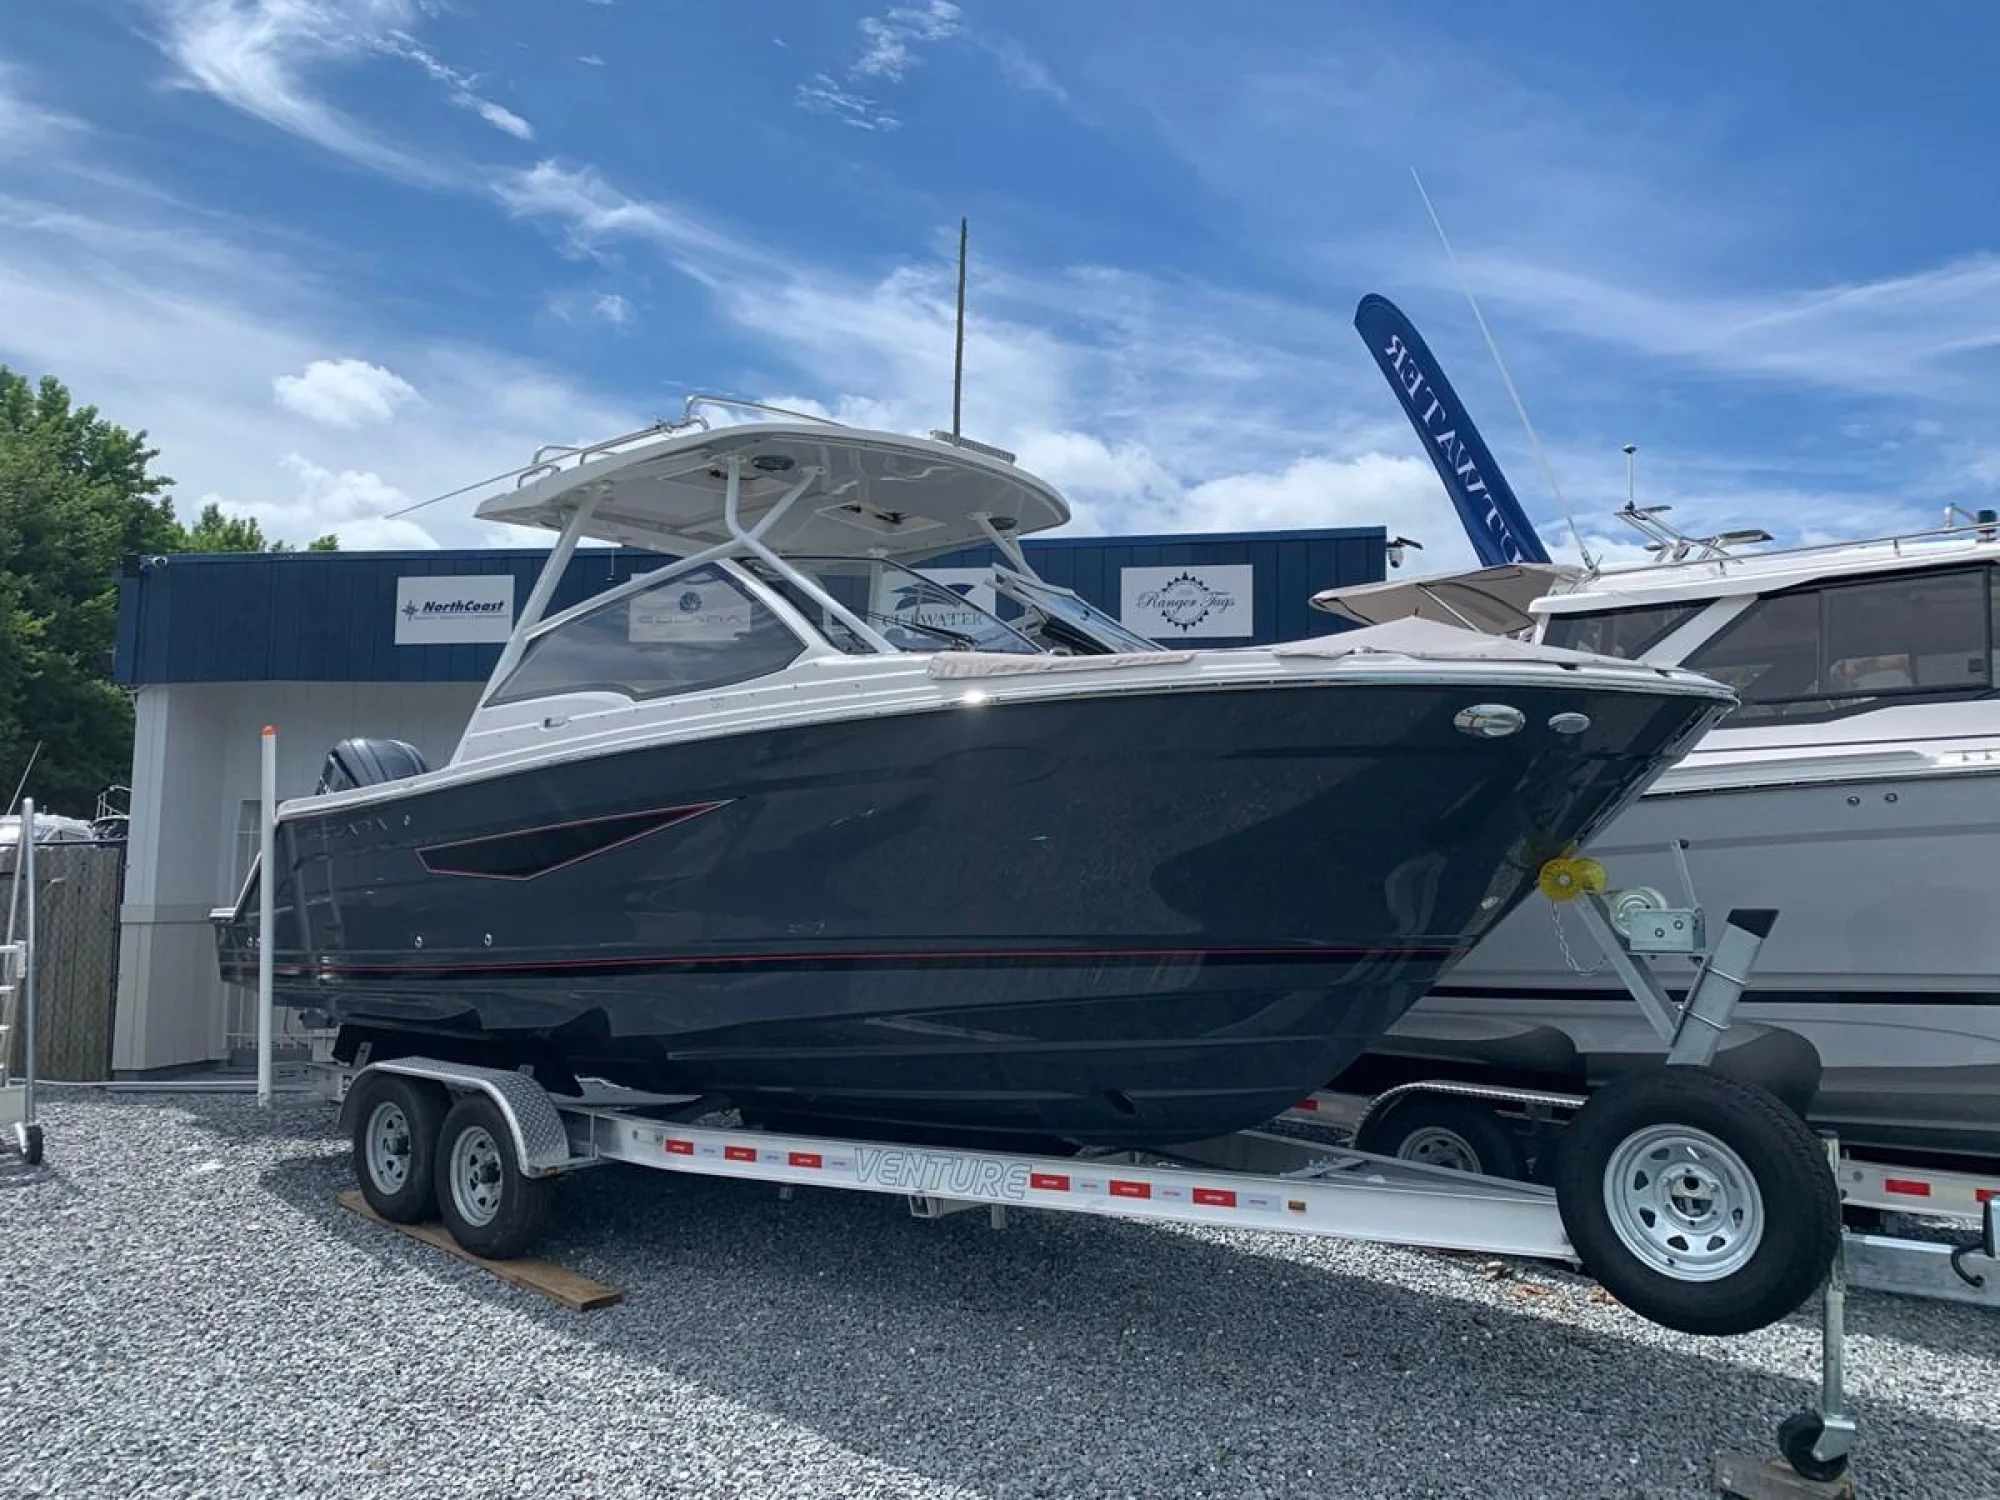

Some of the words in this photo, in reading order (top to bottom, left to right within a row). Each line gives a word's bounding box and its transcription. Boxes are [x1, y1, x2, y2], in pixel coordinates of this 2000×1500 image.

[422, 600, 504, 613] NorthCoast
[1136, 590, 1198, 617] Ranger
[854, 1147, 1032, 1200] VENTURE
